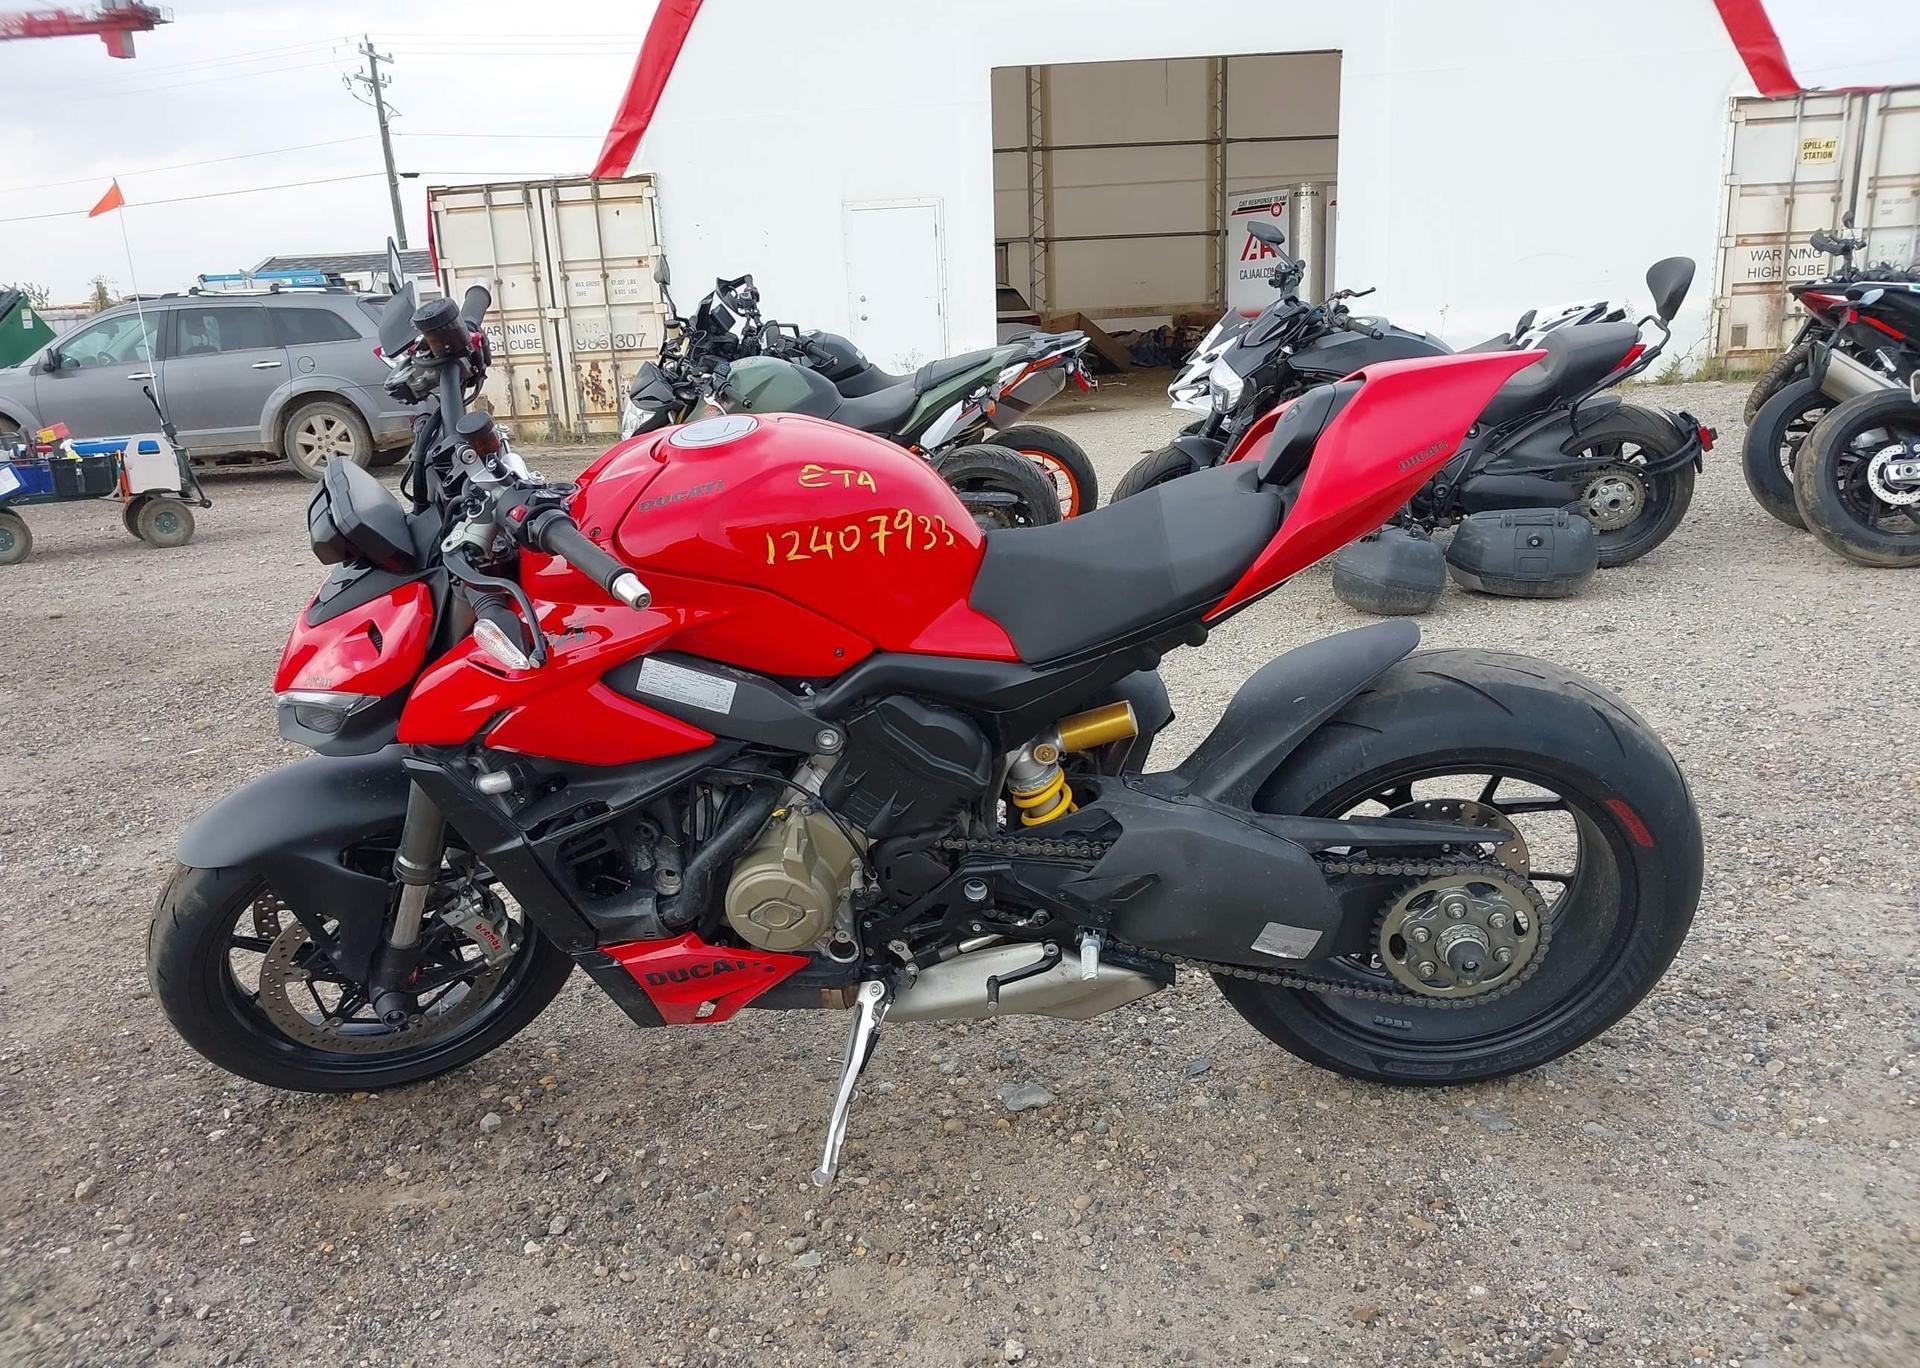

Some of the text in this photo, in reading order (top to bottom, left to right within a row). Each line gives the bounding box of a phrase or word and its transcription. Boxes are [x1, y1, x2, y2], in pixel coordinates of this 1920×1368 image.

[1803, 140, 1837, 150] SPILL-KIT
[1803, 151, 1833, 160] STATION
[1750, 248, 1823, 262] WARNING
[1747, 265, 1781, 279] HIGH
[489, 338, 542, 352] GH CUBE
[1398, 439, 1449, 472] DUCATI
[798, 464, 878, 494] ETA
[638, 479, 725, 513] DUCATI
[764, 507, 956, 566] 12407933
